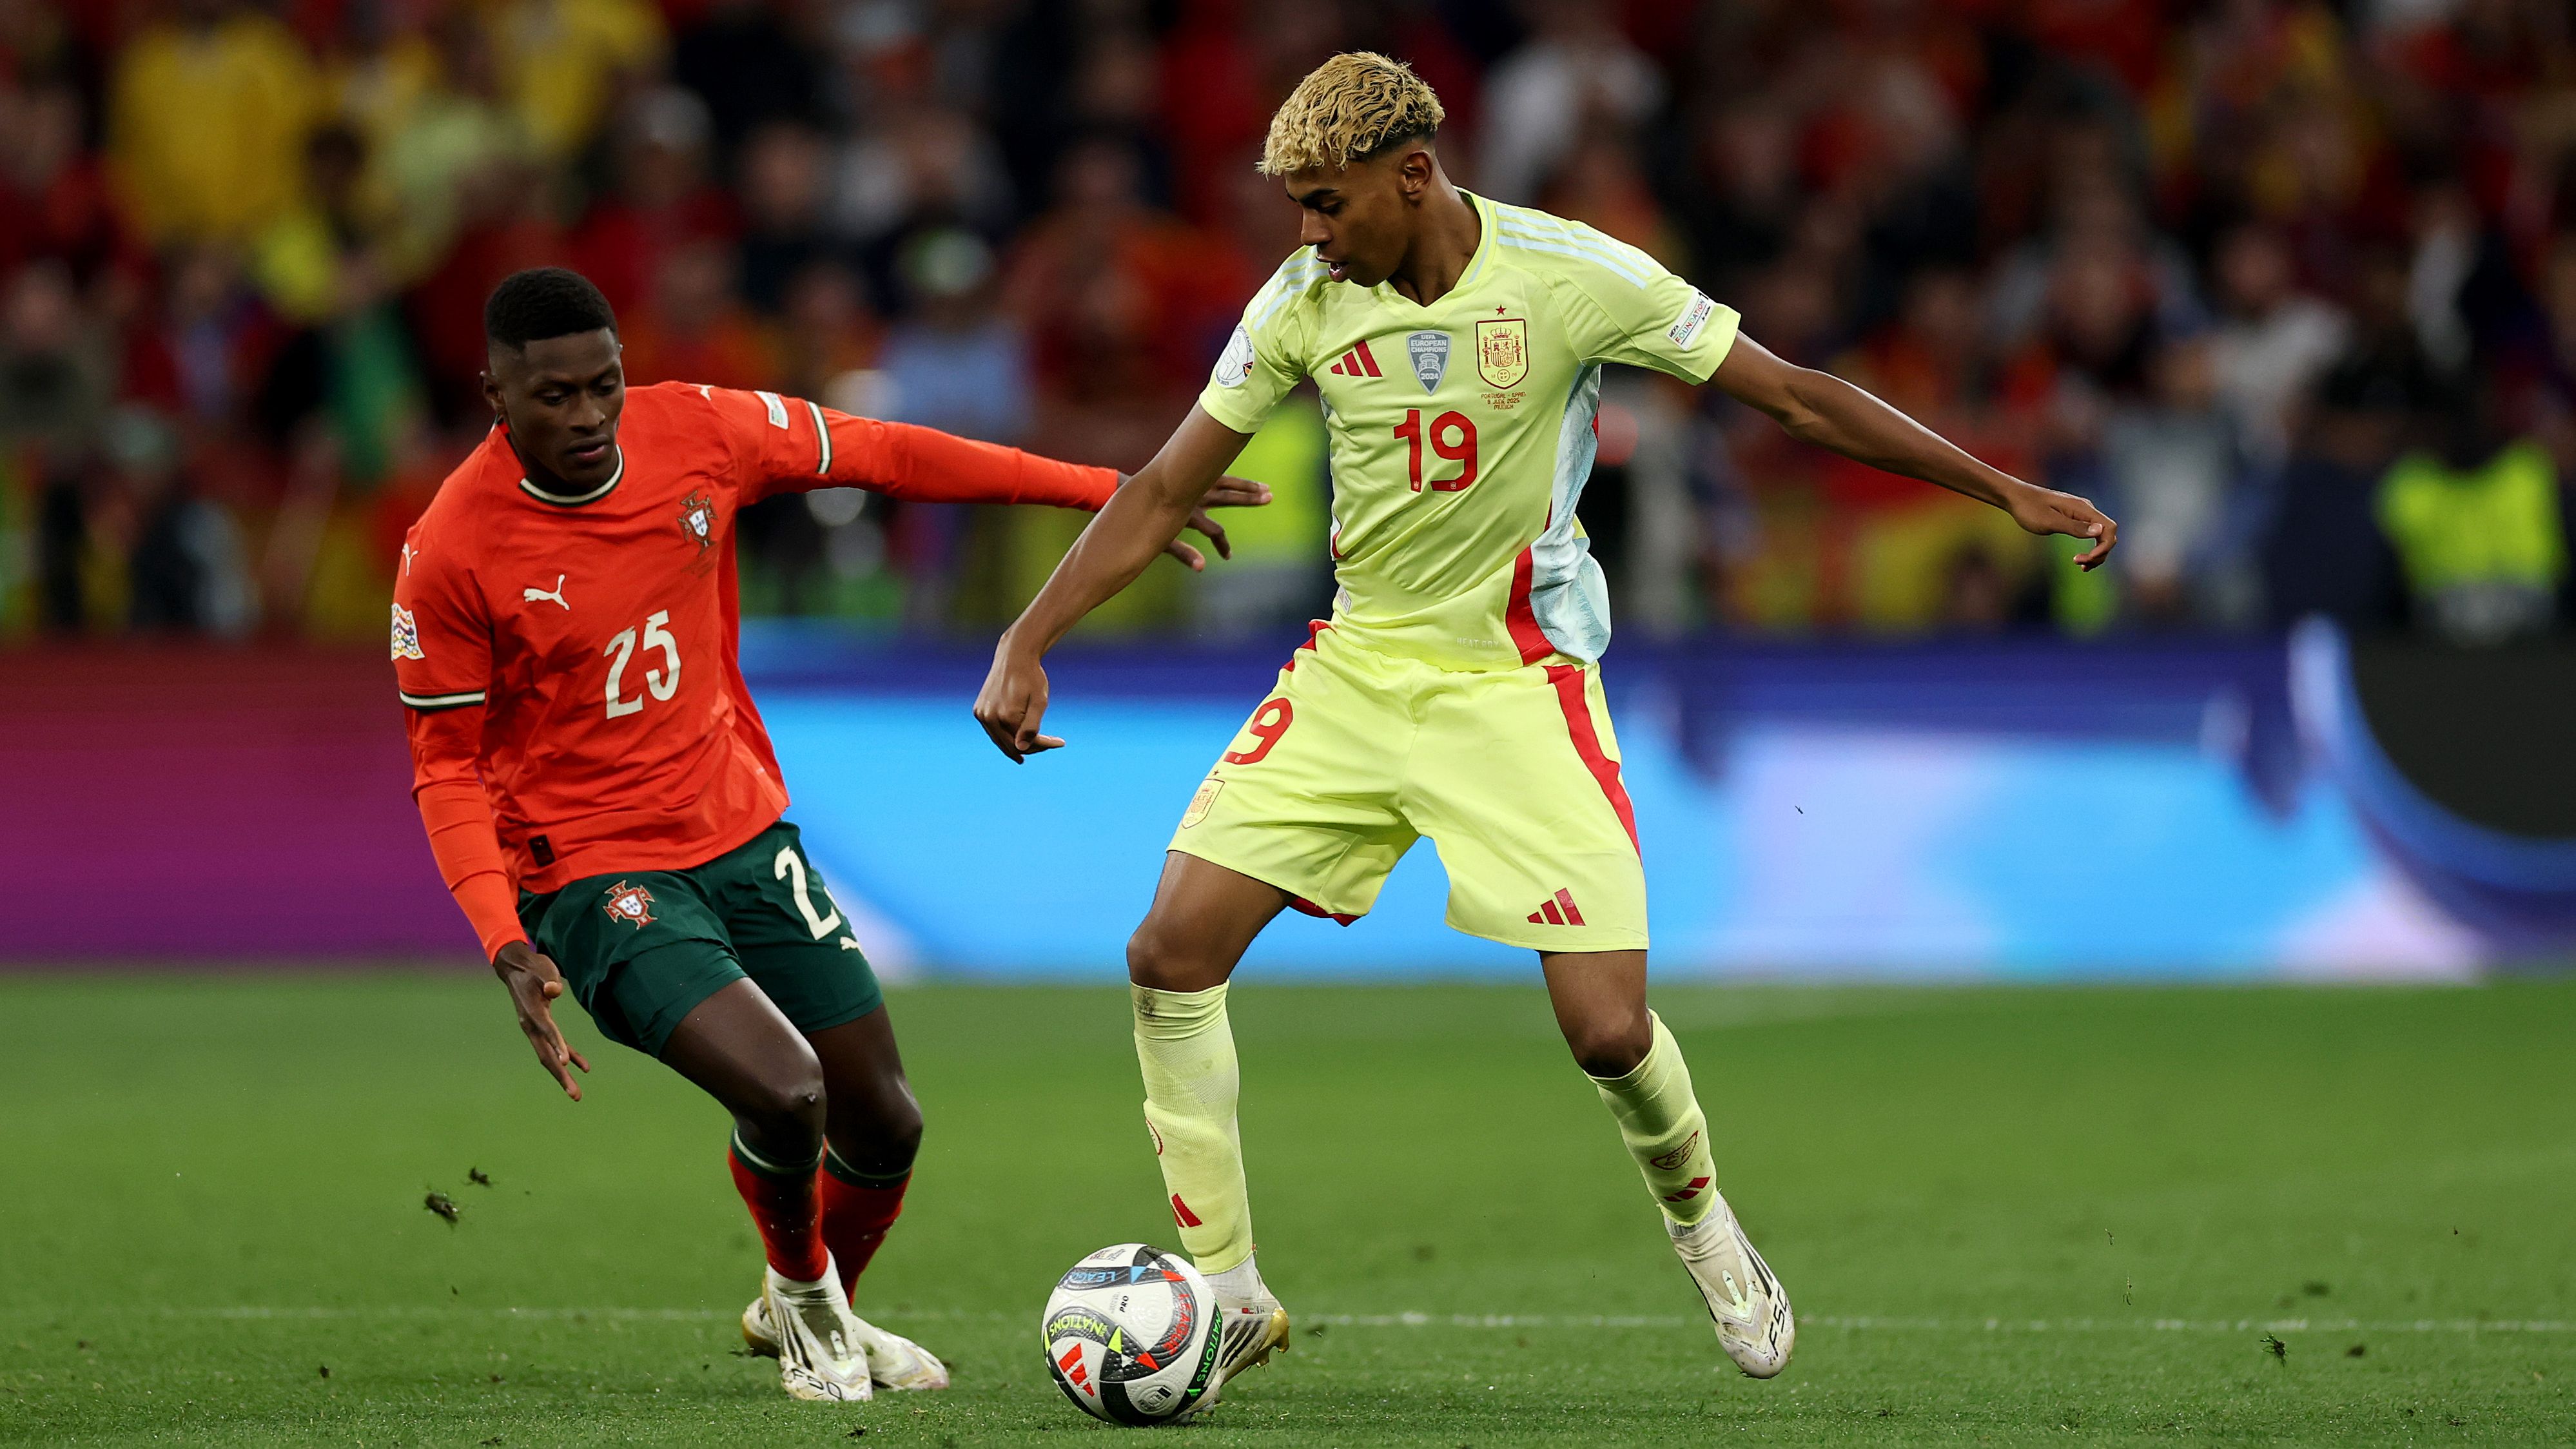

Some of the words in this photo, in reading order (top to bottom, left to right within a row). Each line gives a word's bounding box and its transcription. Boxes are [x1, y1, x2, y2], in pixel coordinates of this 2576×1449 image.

[1675, 298, 1706, 343] FOUNDATION
[1393, 409, 1478, 493] 19
[604, 609, 681, 719] 25
[774, 846, 842, 941] 2
[1049, 1314, 1103, 1337] NATIONS
[1119, 1295, 1129, 1313] PRO
[1162, 1293, 1193, 1356] LEAGUE
[1197, 1314, 1223, 1381] NATIONS
